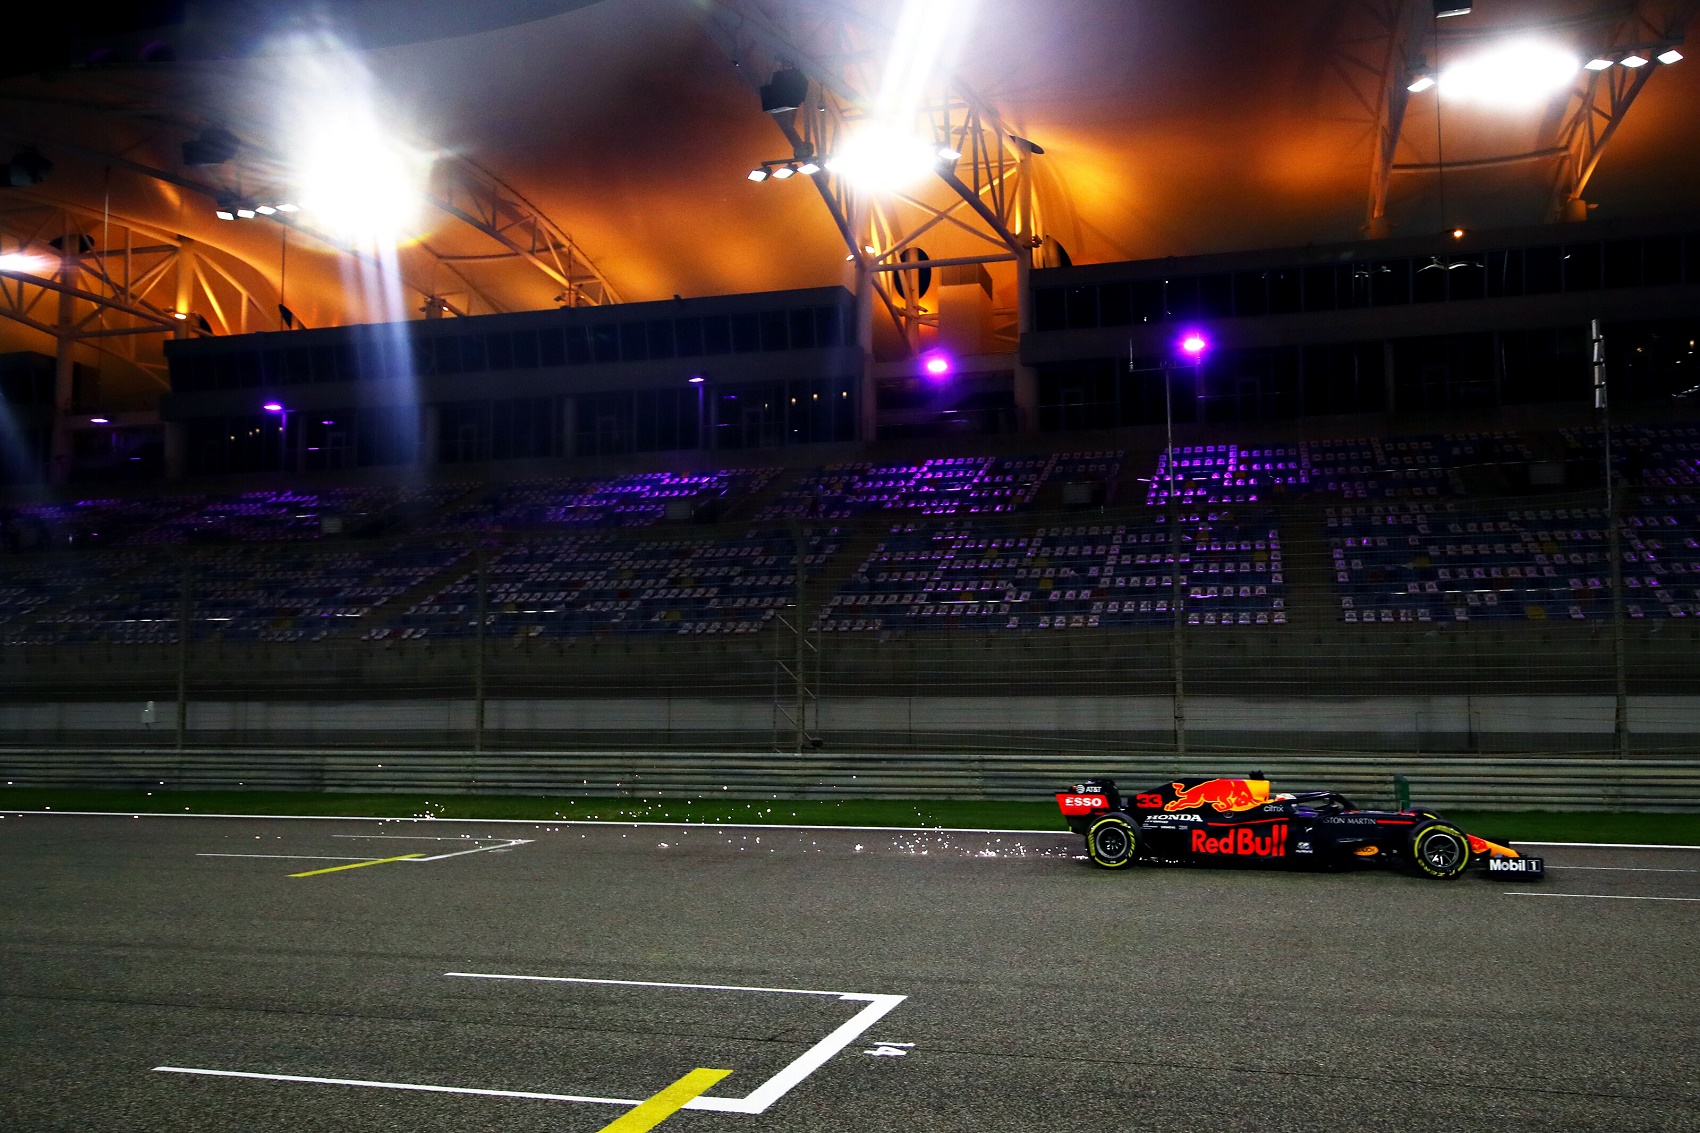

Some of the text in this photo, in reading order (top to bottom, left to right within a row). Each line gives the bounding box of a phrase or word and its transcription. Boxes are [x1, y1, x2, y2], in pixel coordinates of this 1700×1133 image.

[1065, 797, 1102, 807] ESSO
[1135, 793, 1163, 809] 33
[1146, 813, 1203, 823] HONDA
[1347, 817, 1376, 825] MARTIN
[1489, 858, 1526, 871] Mobil
